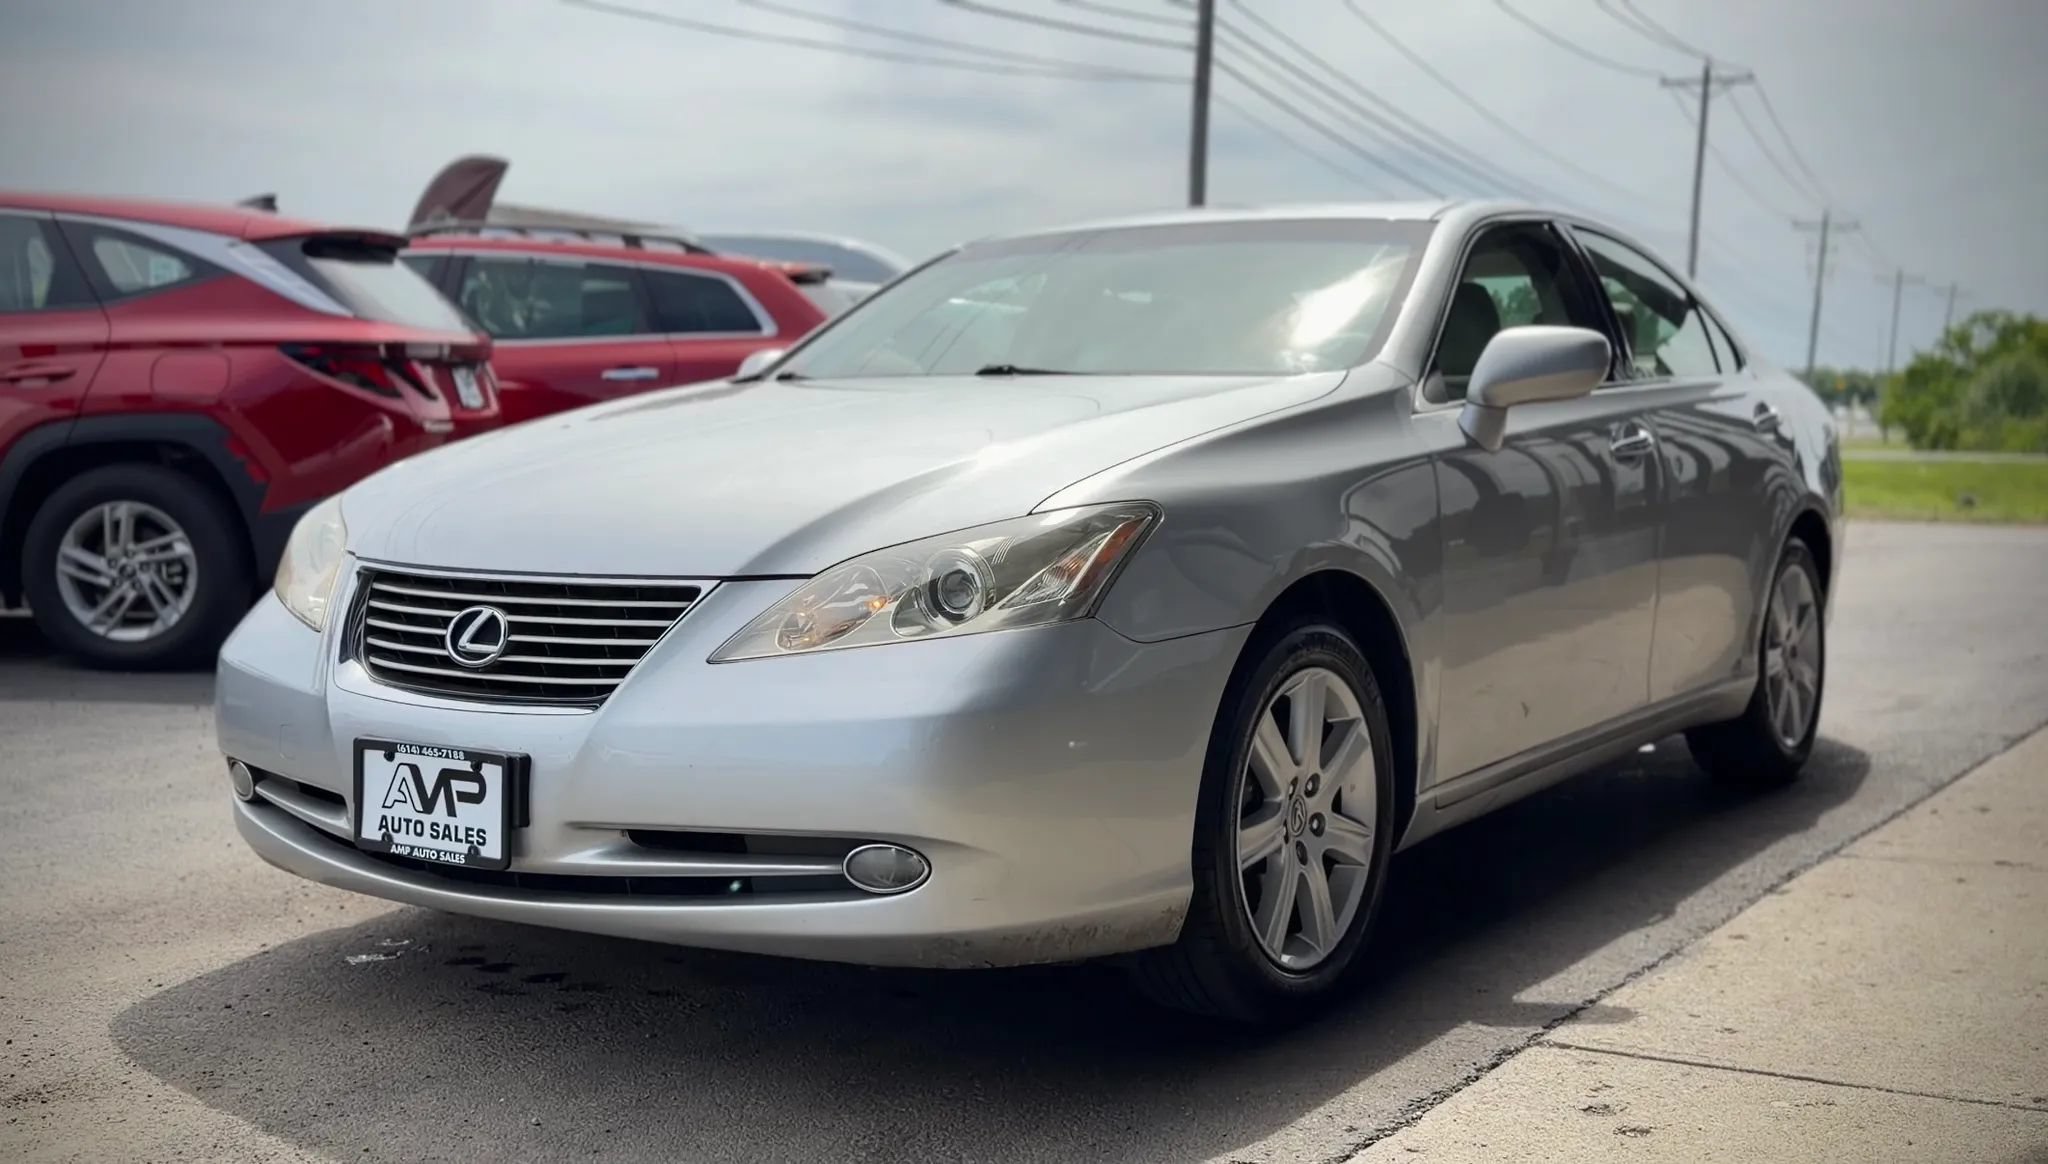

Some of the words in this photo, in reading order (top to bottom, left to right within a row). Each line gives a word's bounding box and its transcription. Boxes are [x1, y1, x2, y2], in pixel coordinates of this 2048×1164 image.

[396, 743, 420, 755] (614)
[378, 814, 424, 837] AUTO
[430, 821, 487, 847] SALES
[390, 843, 411, 856] AMP
[412, 847, 438, 860] AUTO
[439, 851, 466, 864] SALES
